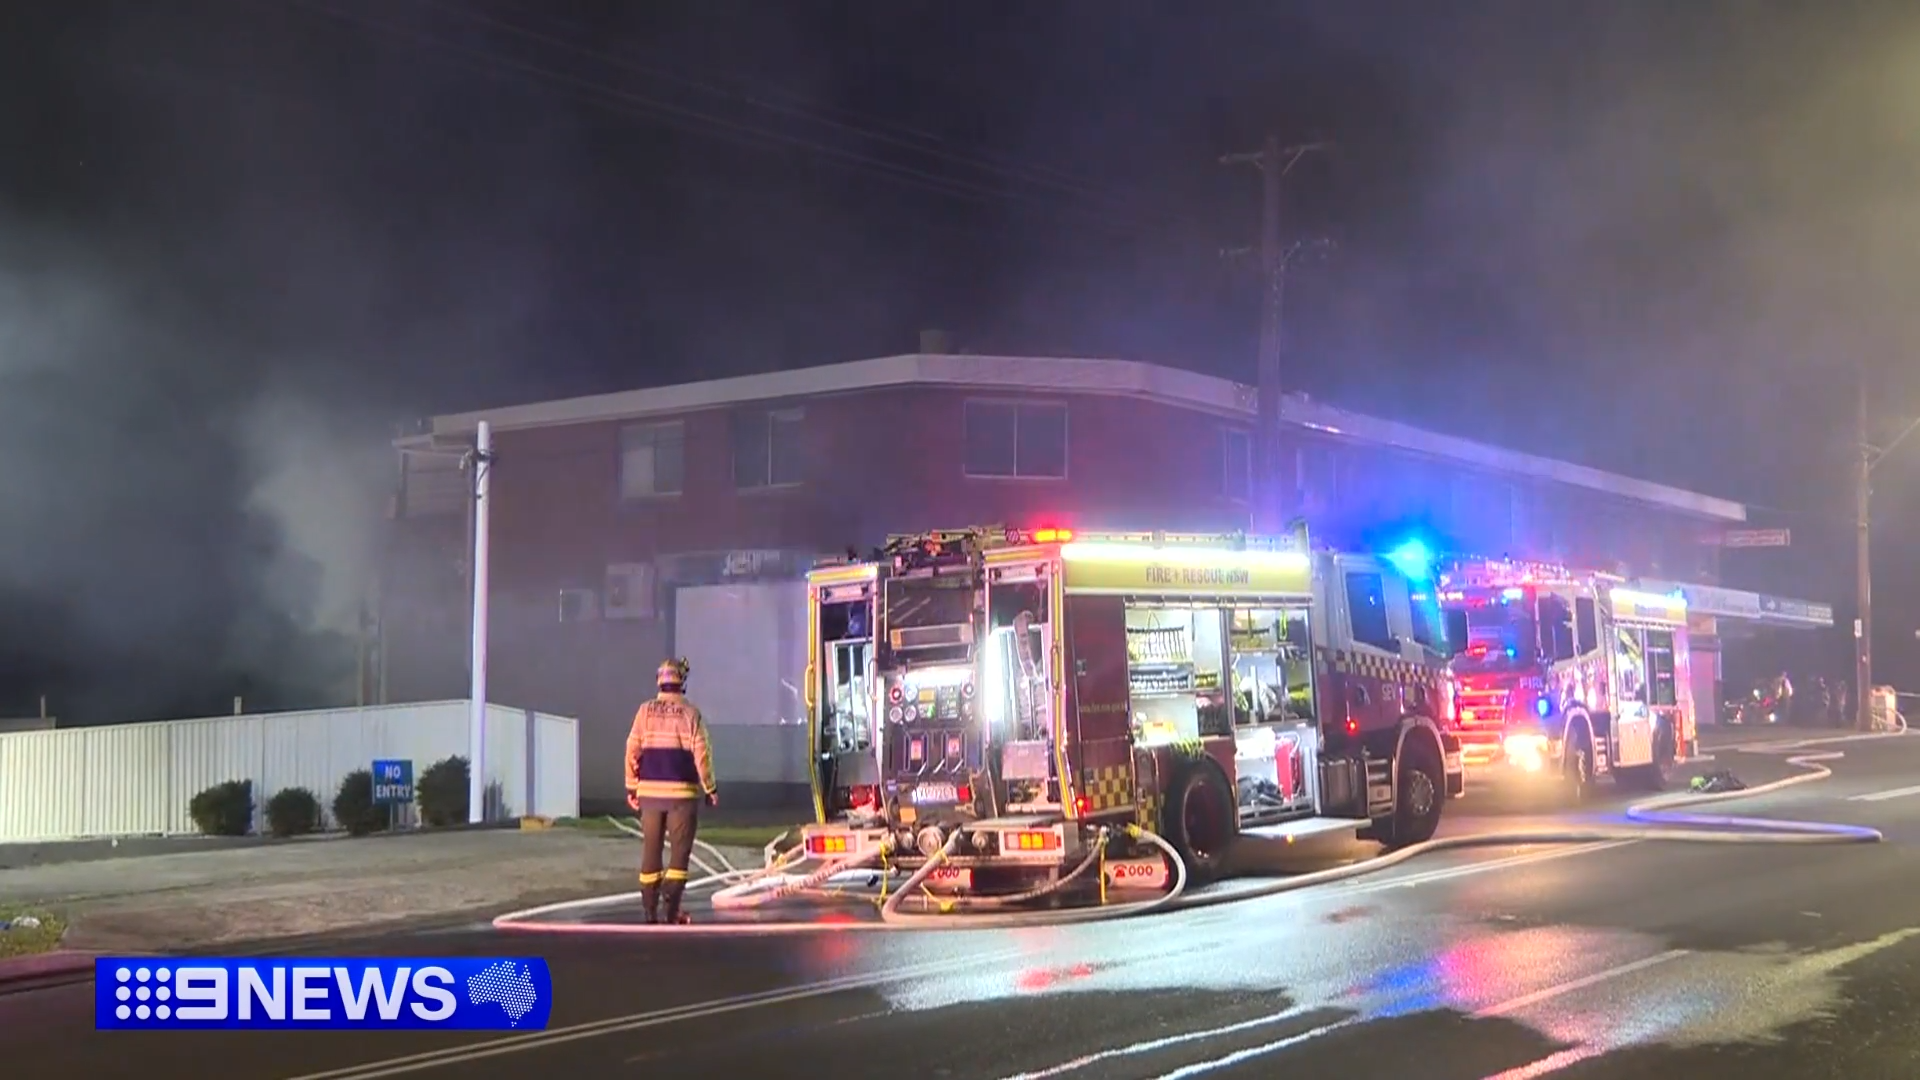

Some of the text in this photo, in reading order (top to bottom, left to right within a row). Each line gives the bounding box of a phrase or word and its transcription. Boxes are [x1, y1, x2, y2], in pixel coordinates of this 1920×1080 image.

[1145, 567, 1172, 584] FIRE
[1182, 567, 1225, 585] RESCUE
[384, 764, 402, 779] NO
[375, 784, 412, 799] ENTRY
[1128, 865, 1154, 877] 000
